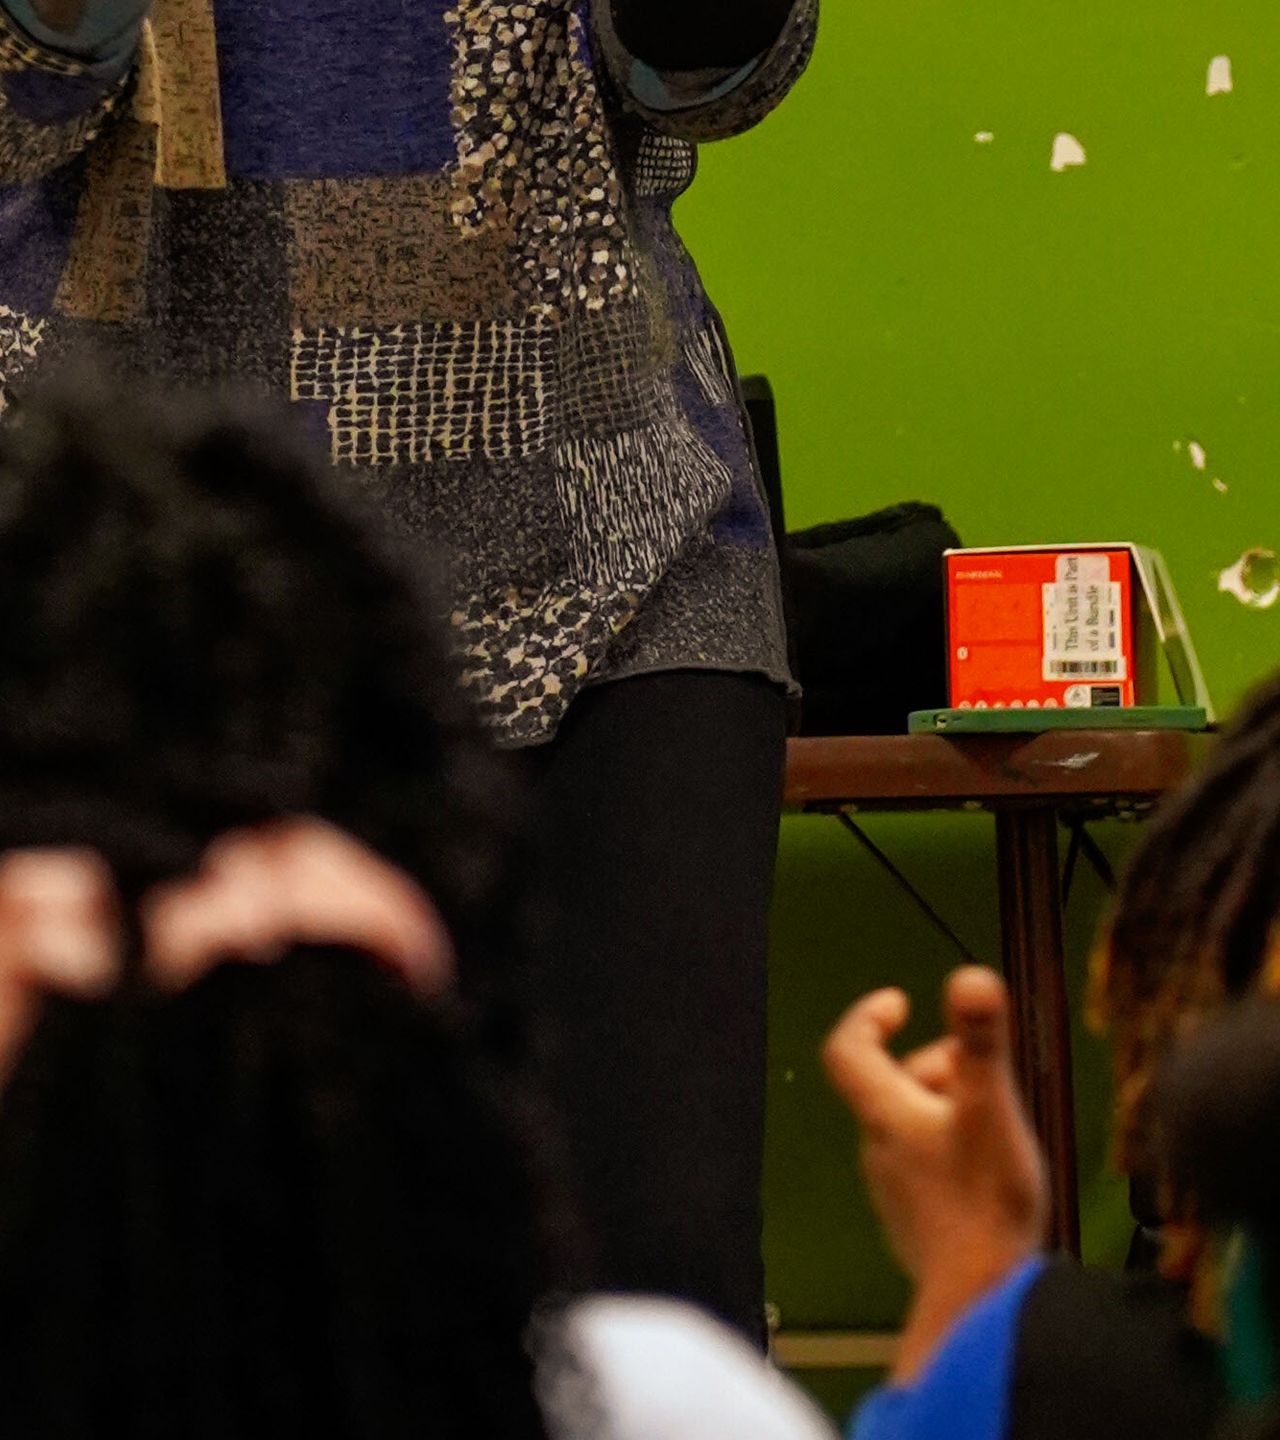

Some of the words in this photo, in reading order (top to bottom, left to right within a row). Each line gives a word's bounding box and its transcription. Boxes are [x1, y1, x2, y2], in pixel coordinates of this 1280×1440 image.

[1064, 557, 1079, 581] Part
[1066, 584, 1079, 595] is
[1064, 597, 1079, 624] Unit
[1085, 585, 1100, 627] Bundle
[1064, 626, 1079, 651] This
[1086, 638, 1099, 651] of
